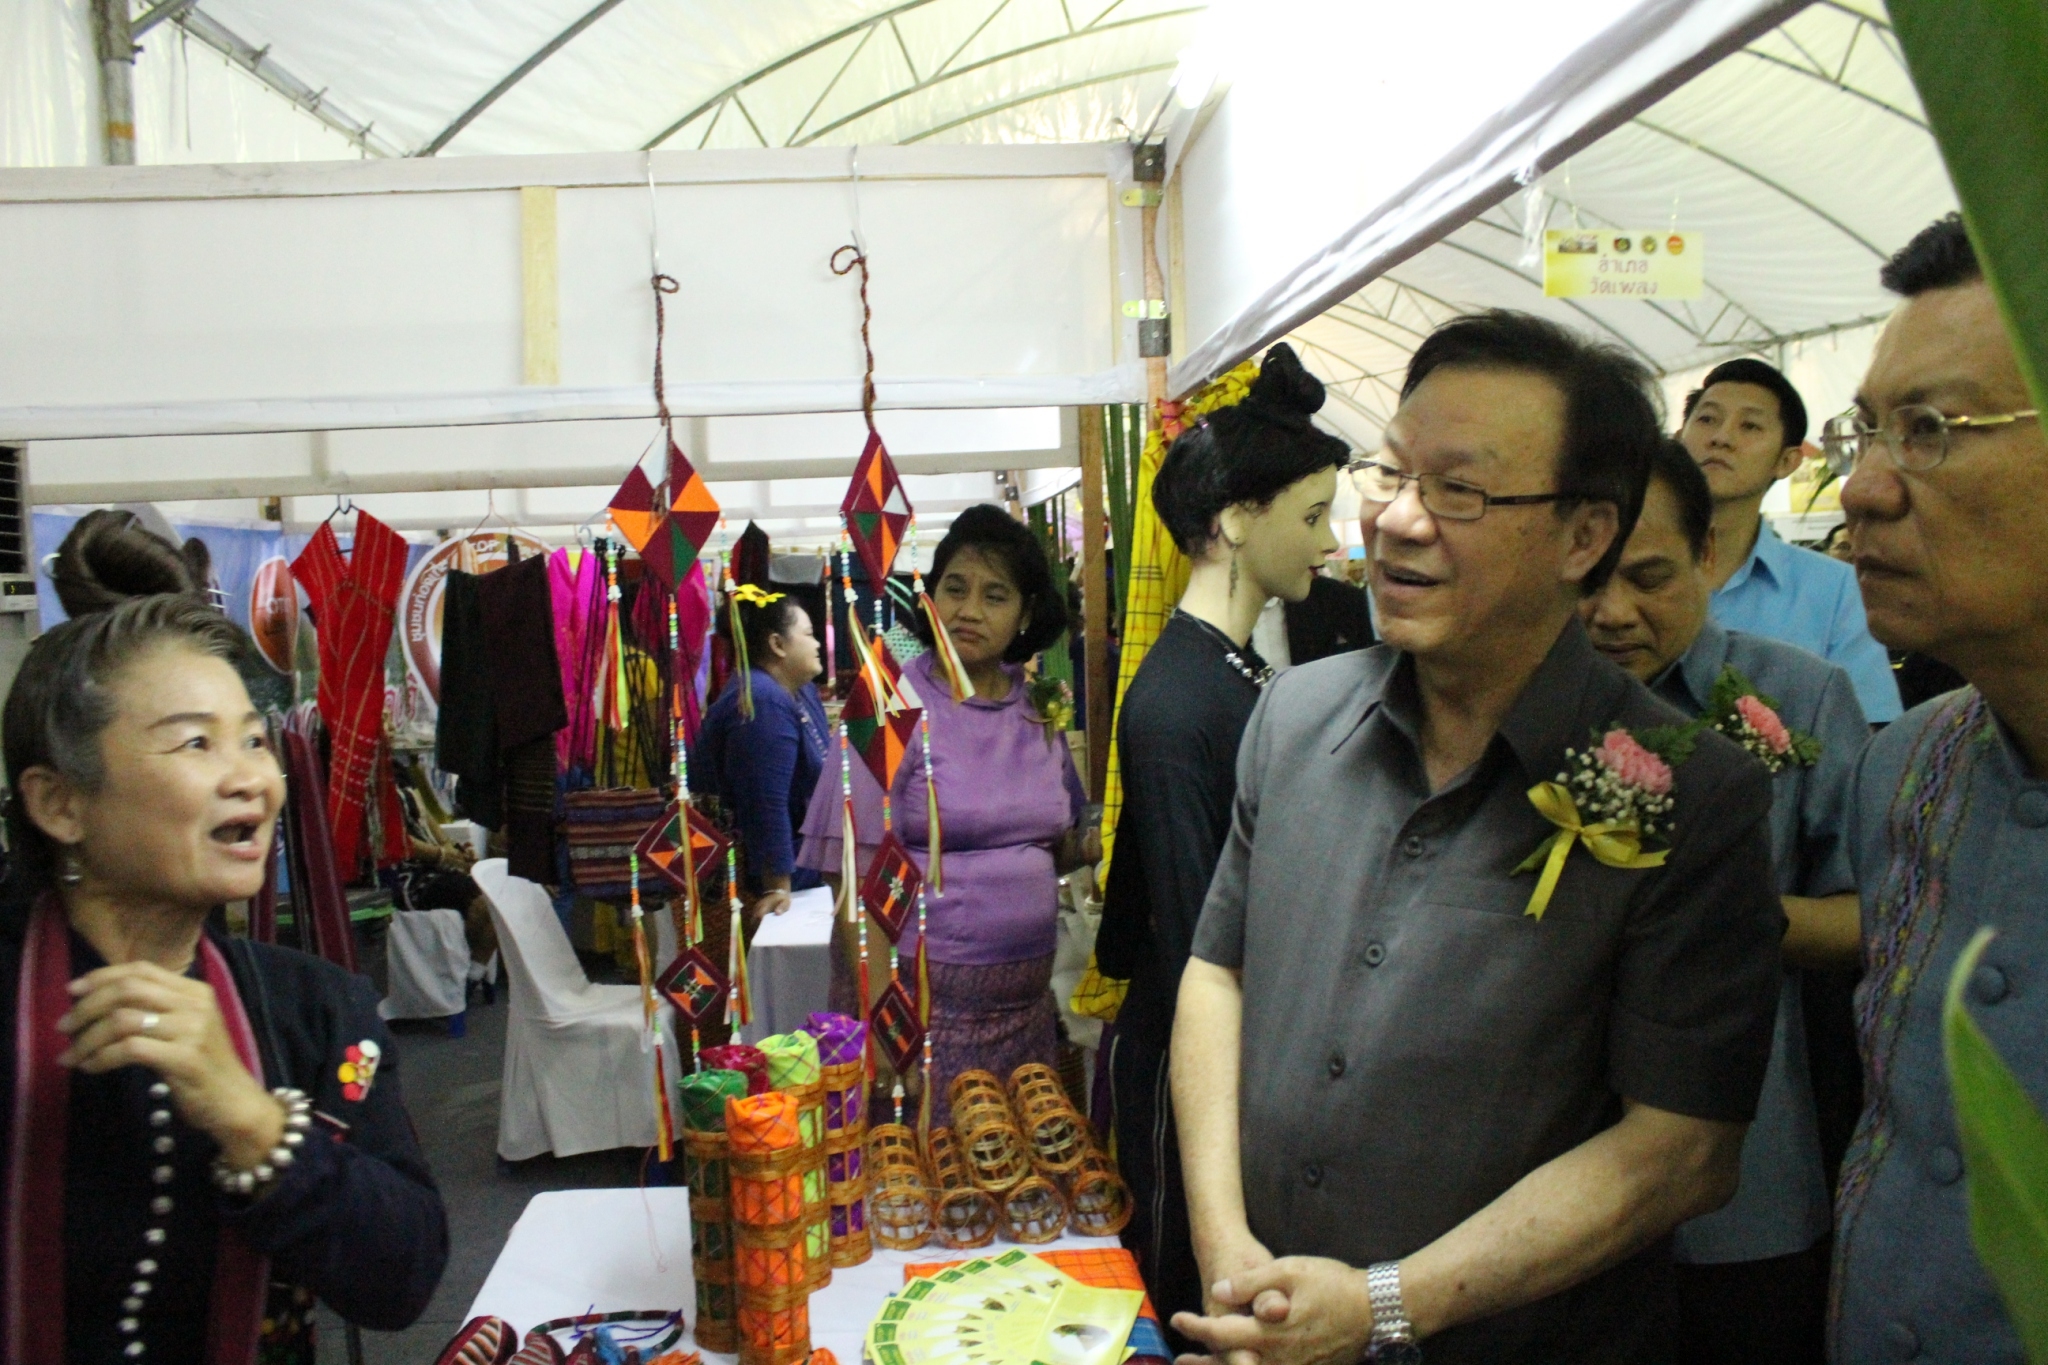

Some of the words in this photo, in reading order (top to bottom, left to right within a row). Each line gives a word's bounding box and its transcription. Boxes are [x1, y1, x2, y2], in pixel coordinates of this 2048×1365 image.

[1598, 253, 1648, 274] อำเภอ
[1590, 275, 1658, 295] วัดเพลง
